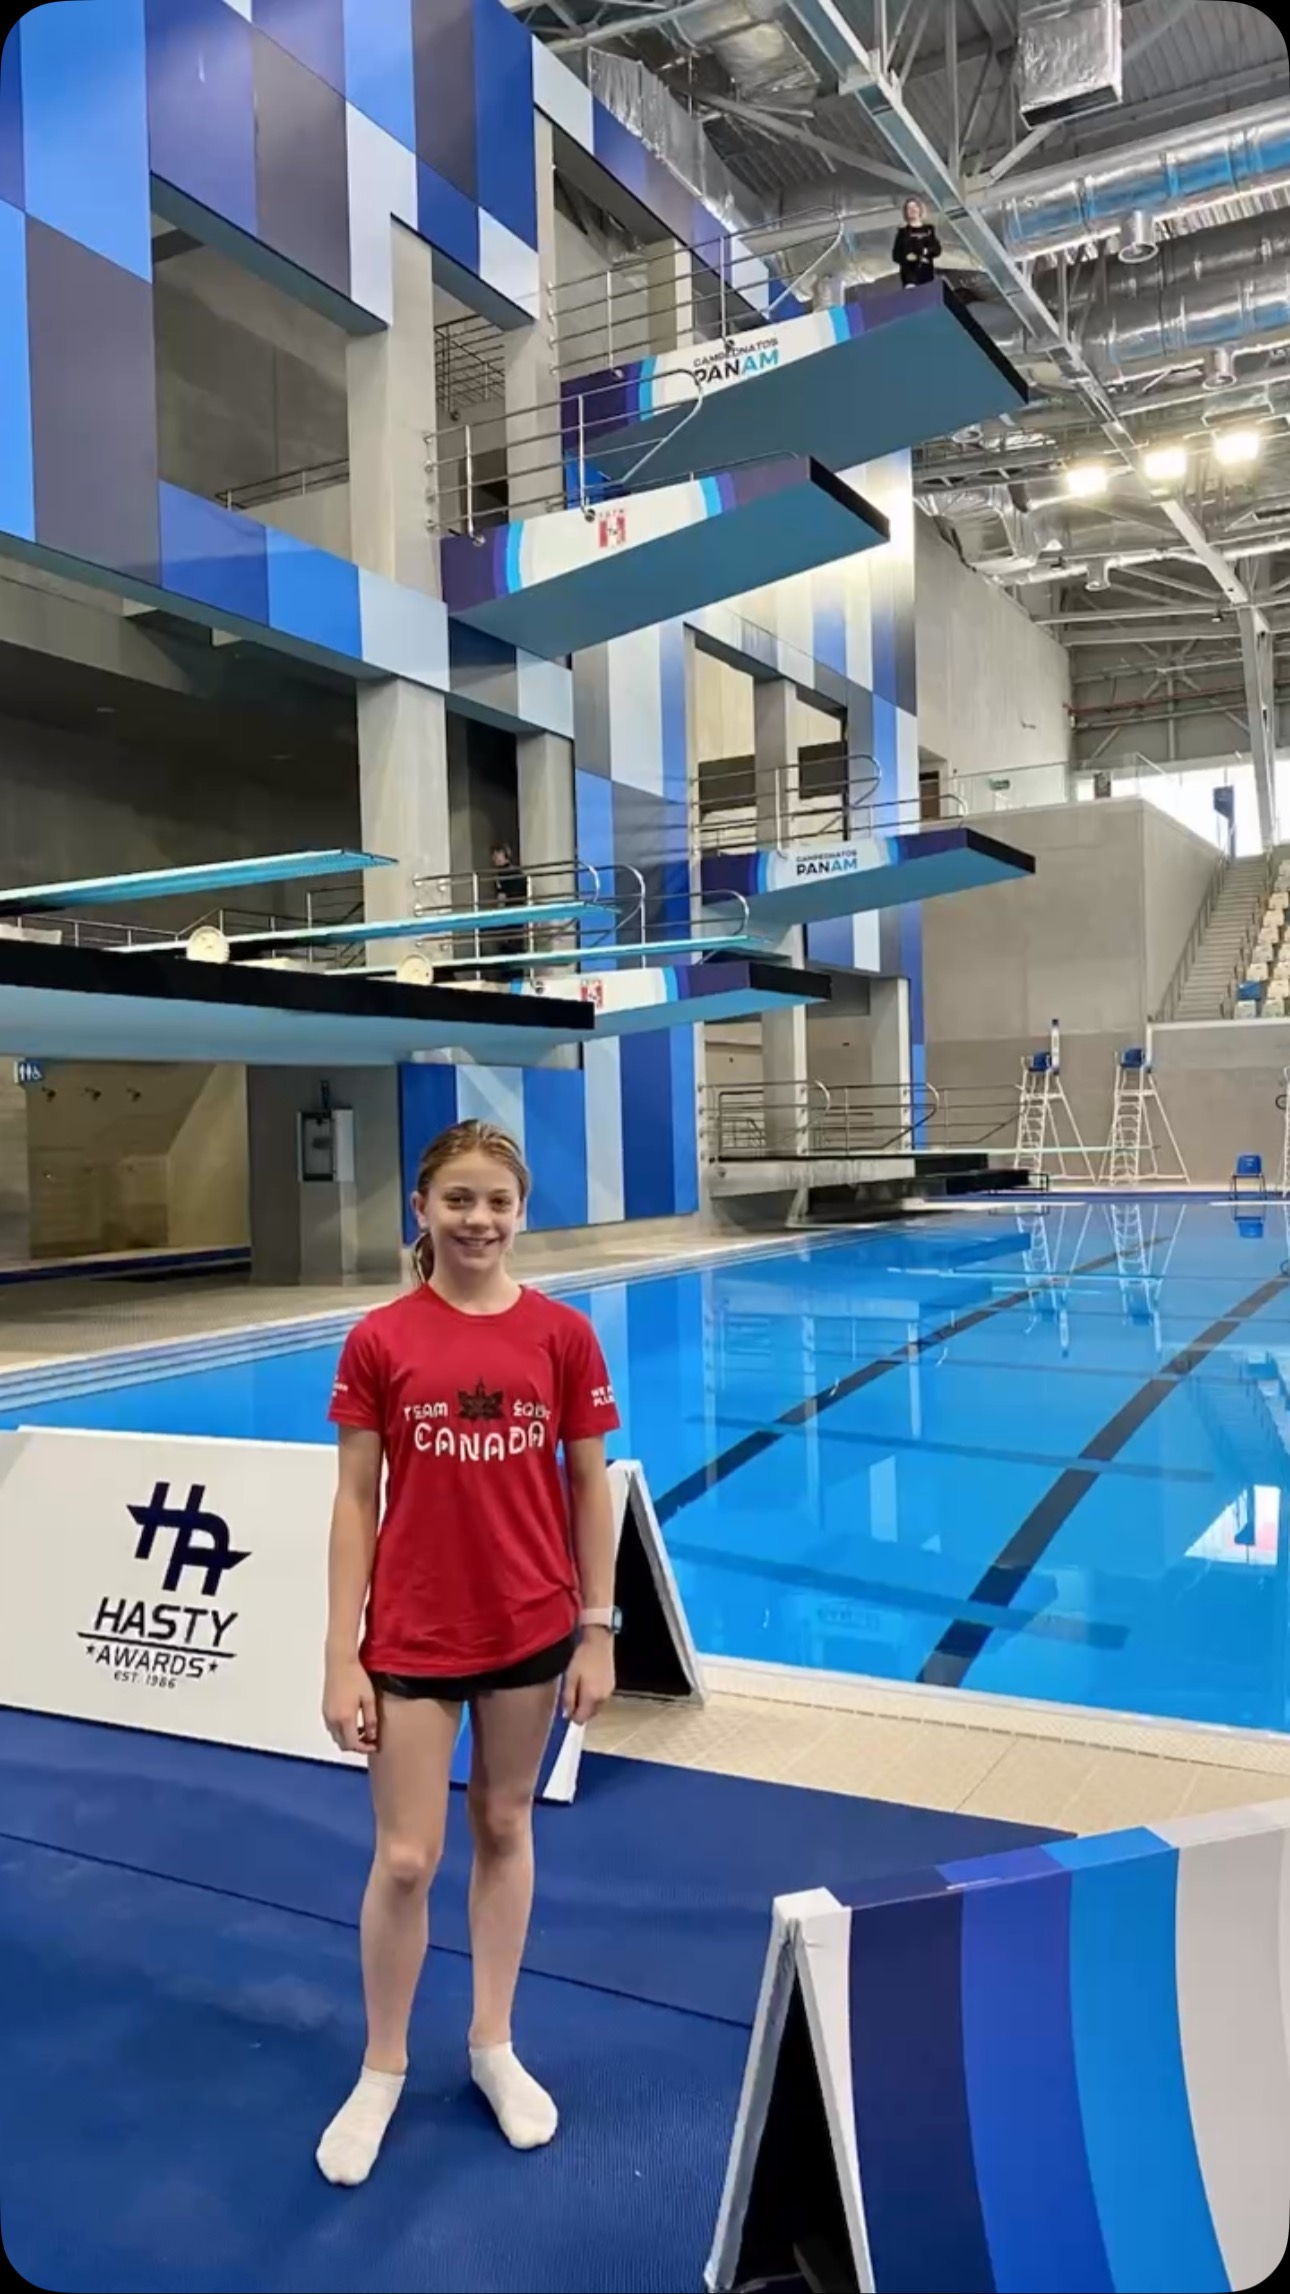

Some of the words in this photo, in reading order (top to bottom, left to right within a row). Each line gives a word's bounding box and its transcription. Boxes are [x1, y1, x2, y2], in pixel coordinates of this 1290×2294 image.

[694, 348, 778, 383] PANAM
[796, 857, 857, 876] PANAM
[403, 1401, 449, 1421] TEAM
[414, 1421, 545, 1462] CANADA
[94, 1597, 238, 1647] HASTY
[95, 1644, 205, 1679] AWARDS
[145, 1674, 176, 1689] 1986
